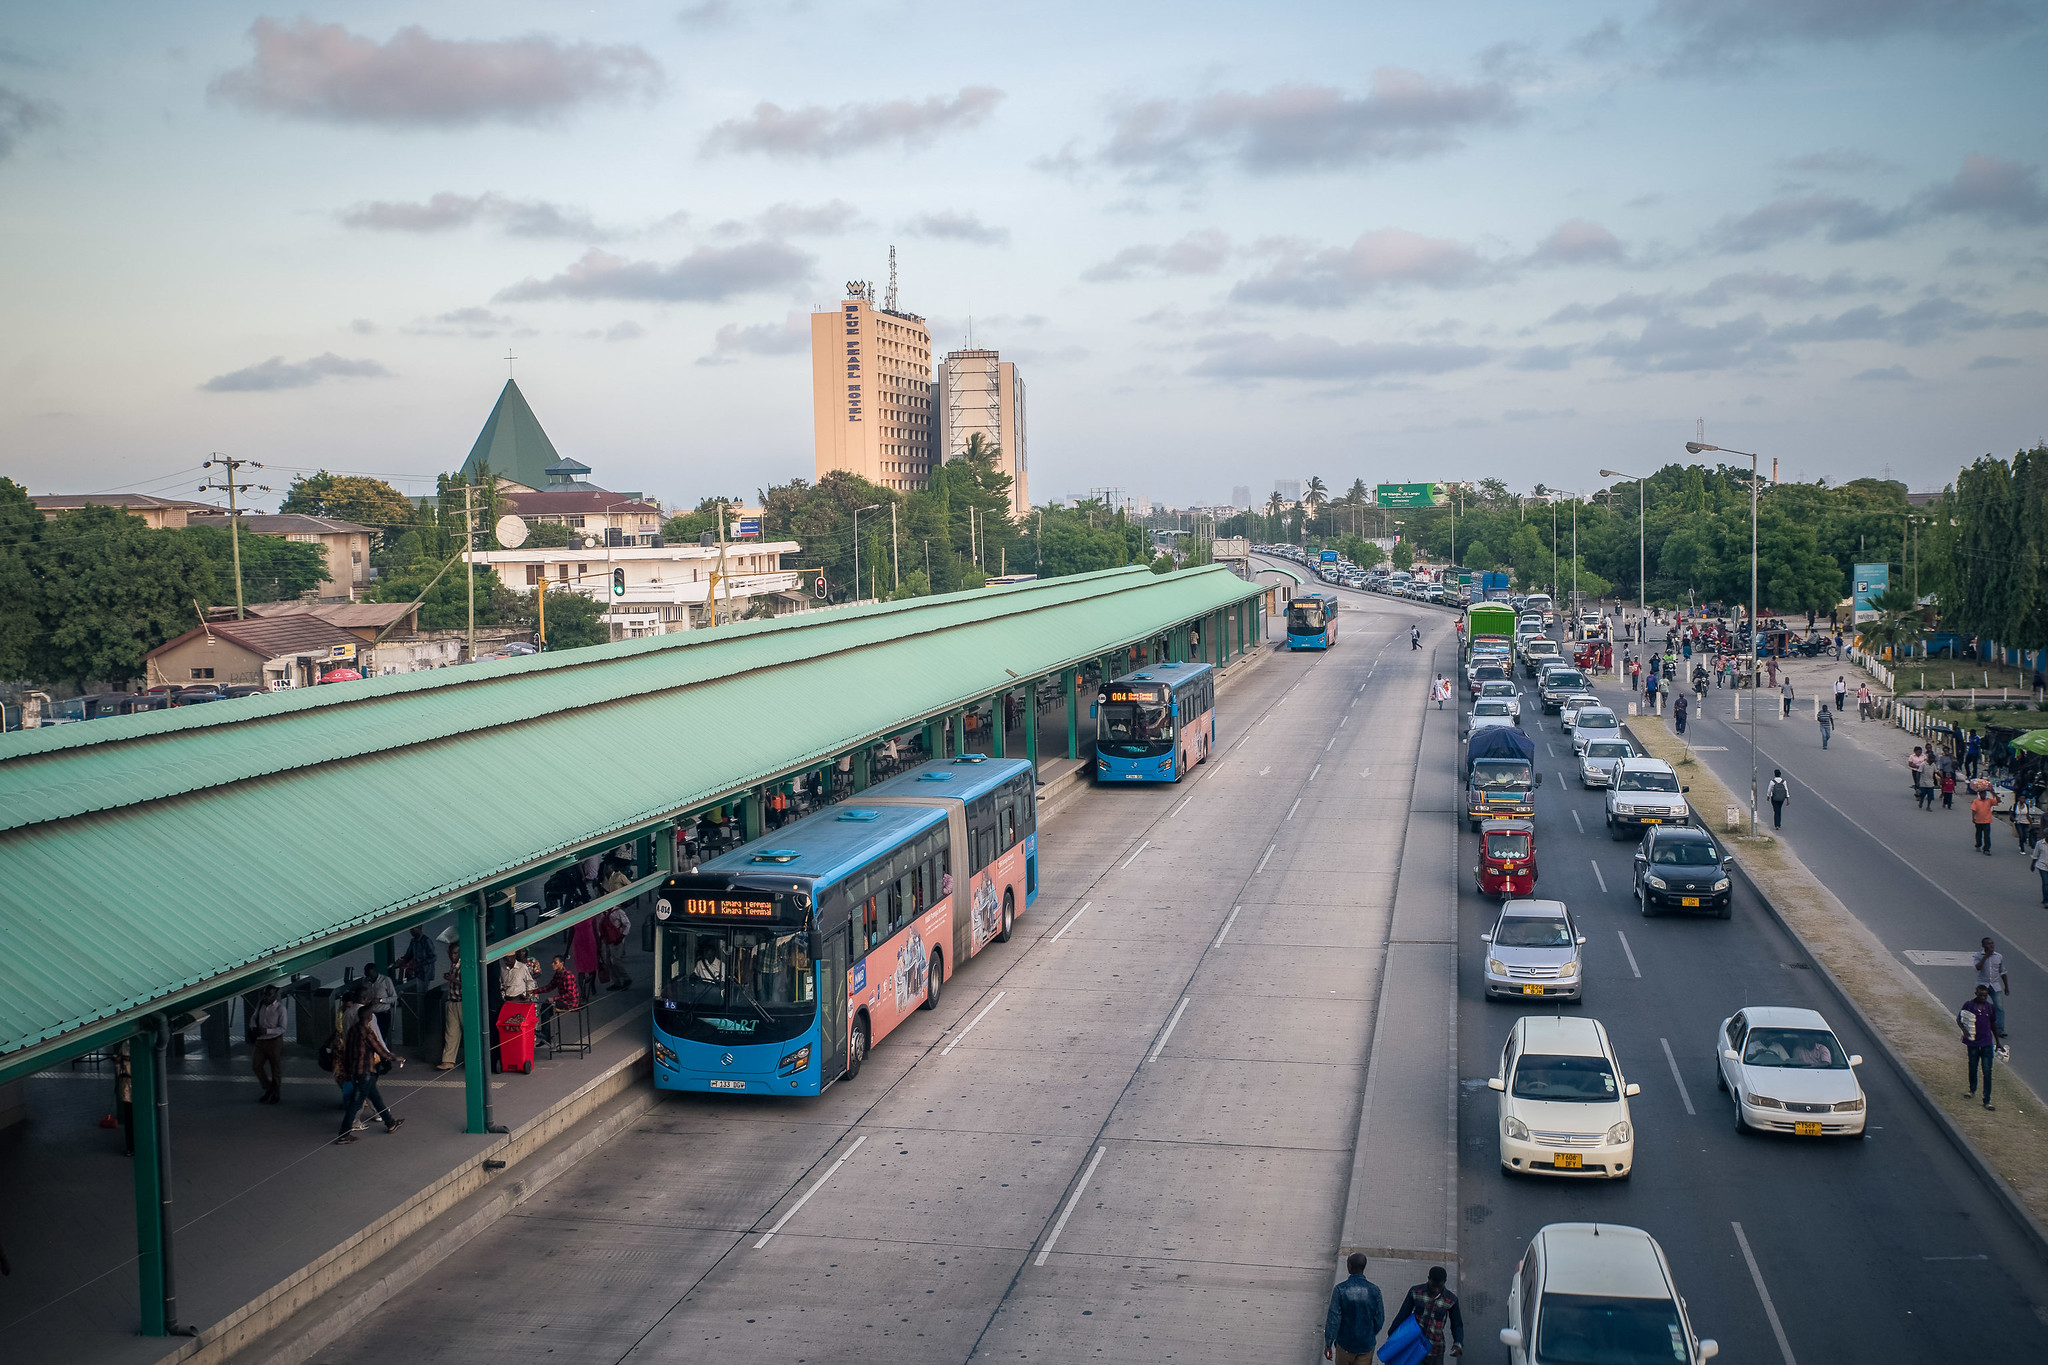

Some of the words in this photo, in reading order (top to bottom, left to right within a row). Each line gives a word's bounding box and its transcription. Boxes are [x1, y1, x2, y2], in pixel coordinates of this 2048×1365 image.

[845, 305, 859, 335] BLUE
[846, 341, 861, 379] PEARL
[848, 384, 862, 422] HOTEL
[1112, 692, 1127, 701] 004
[687, 899, 716, 915] 001
[721, 907, 742, 915] Kimara
[744, 907, 772, 916] Terminal
[854, 969, 864, 985] NMB
[717, 1019, 760, 1031] DART
